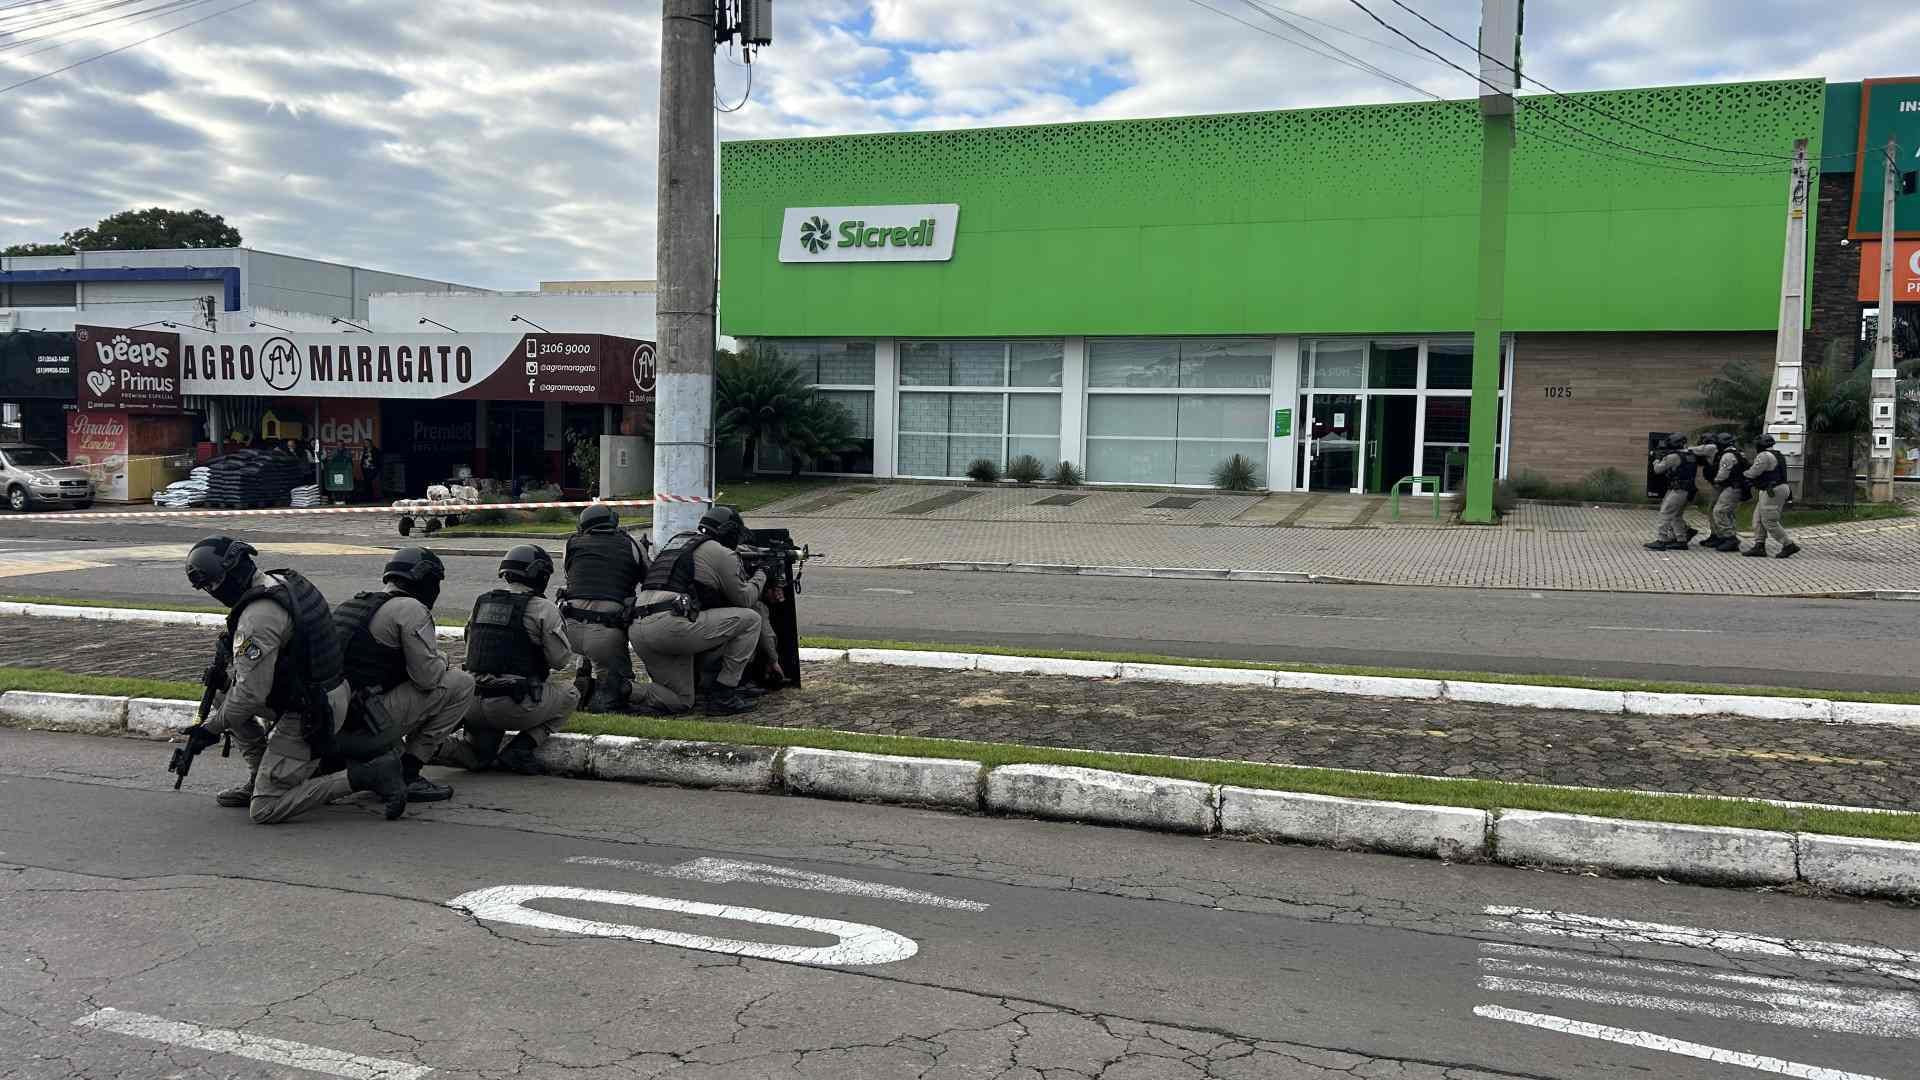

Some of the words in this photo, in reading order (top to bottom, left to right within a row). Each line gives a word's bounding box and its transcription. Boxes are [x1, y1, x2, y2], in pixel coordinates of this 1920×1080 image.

[837, 218, 936, 248] Sicredi
[96, 341, 170, 368] beeps
[540, 342, 563, 355] 3106
[565, 343, 591, 356] 9000
[183, 344, 255, 381] AGRO
[309, 345, 472, 384] MARAGATO
[540, 363, 596, 374] @agromaragato
[120, 369, 174, 392] Primus
[540, 383, 596, 394] @agromaragato
[1544, 386, 1572, 398] 1025
